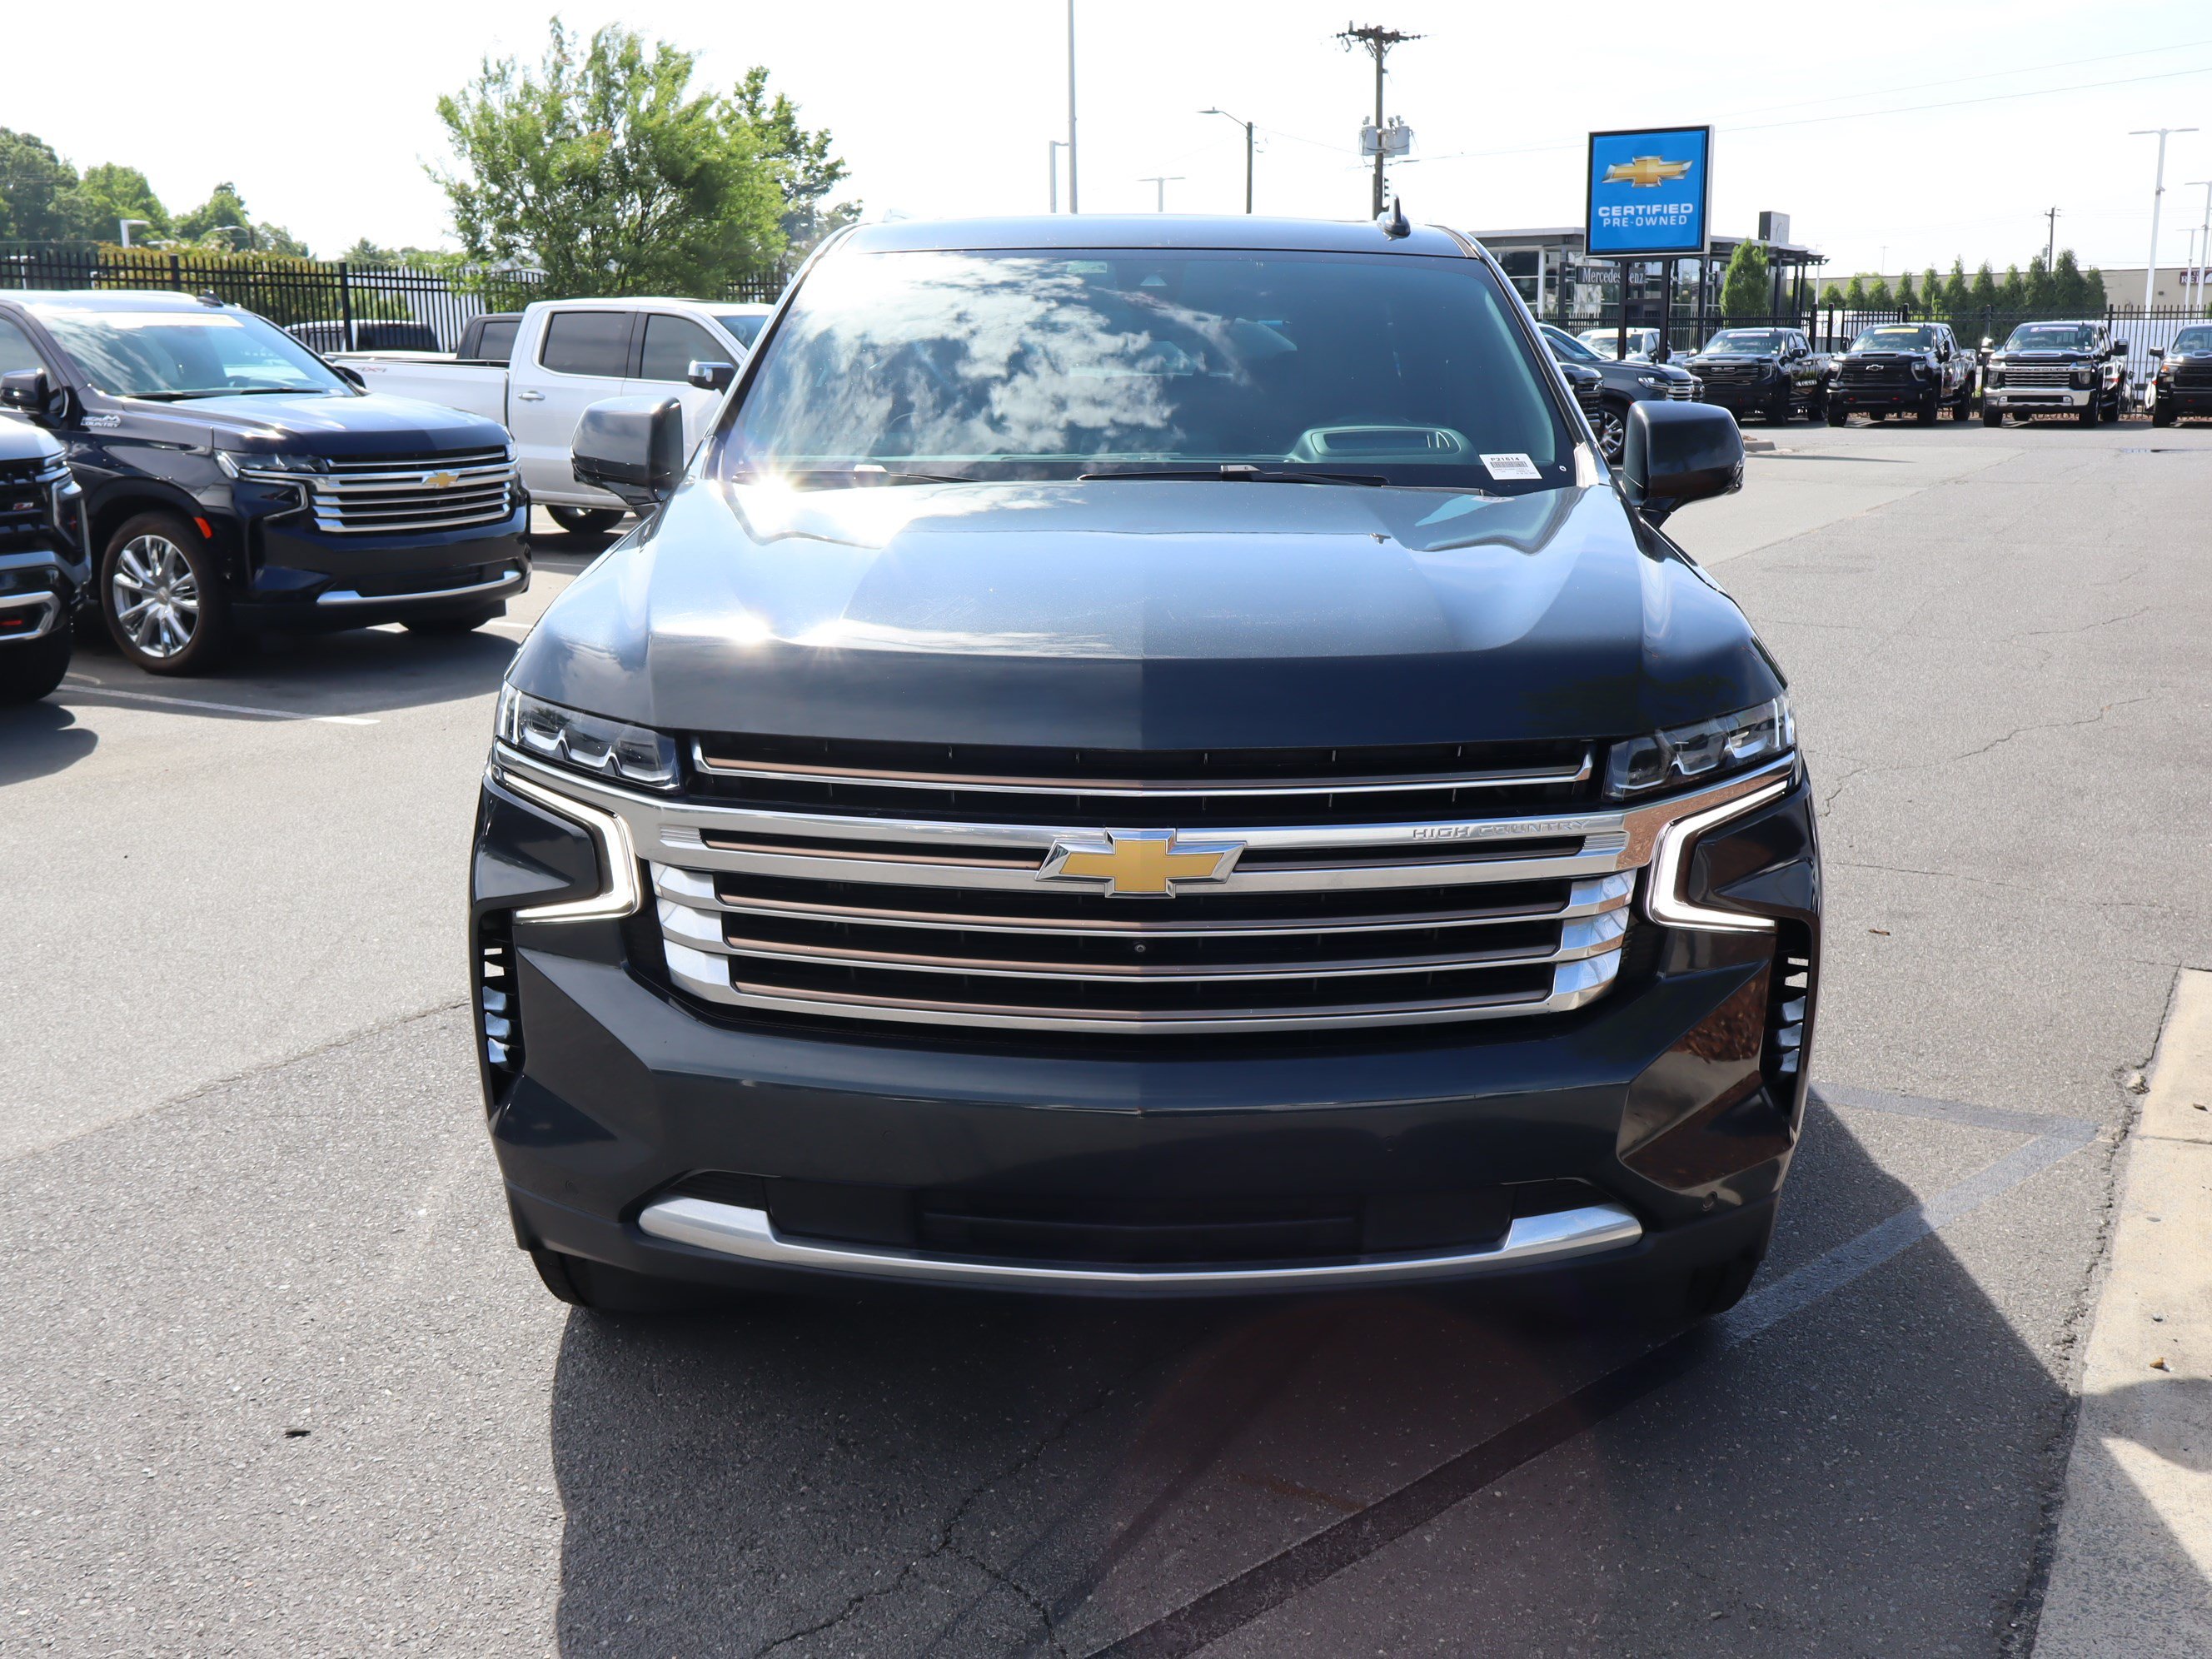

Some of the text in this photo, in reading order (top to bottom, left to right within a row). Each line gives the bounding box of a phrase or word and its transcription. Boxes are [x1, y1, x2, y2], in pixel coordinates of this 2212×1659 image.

[1598, 203, 1693, 217] CERTIFIED
[1603, 215, 1687, 227] PRE-OWNED
[1412, 820, 1590, 840] HIGH COUNTRY
